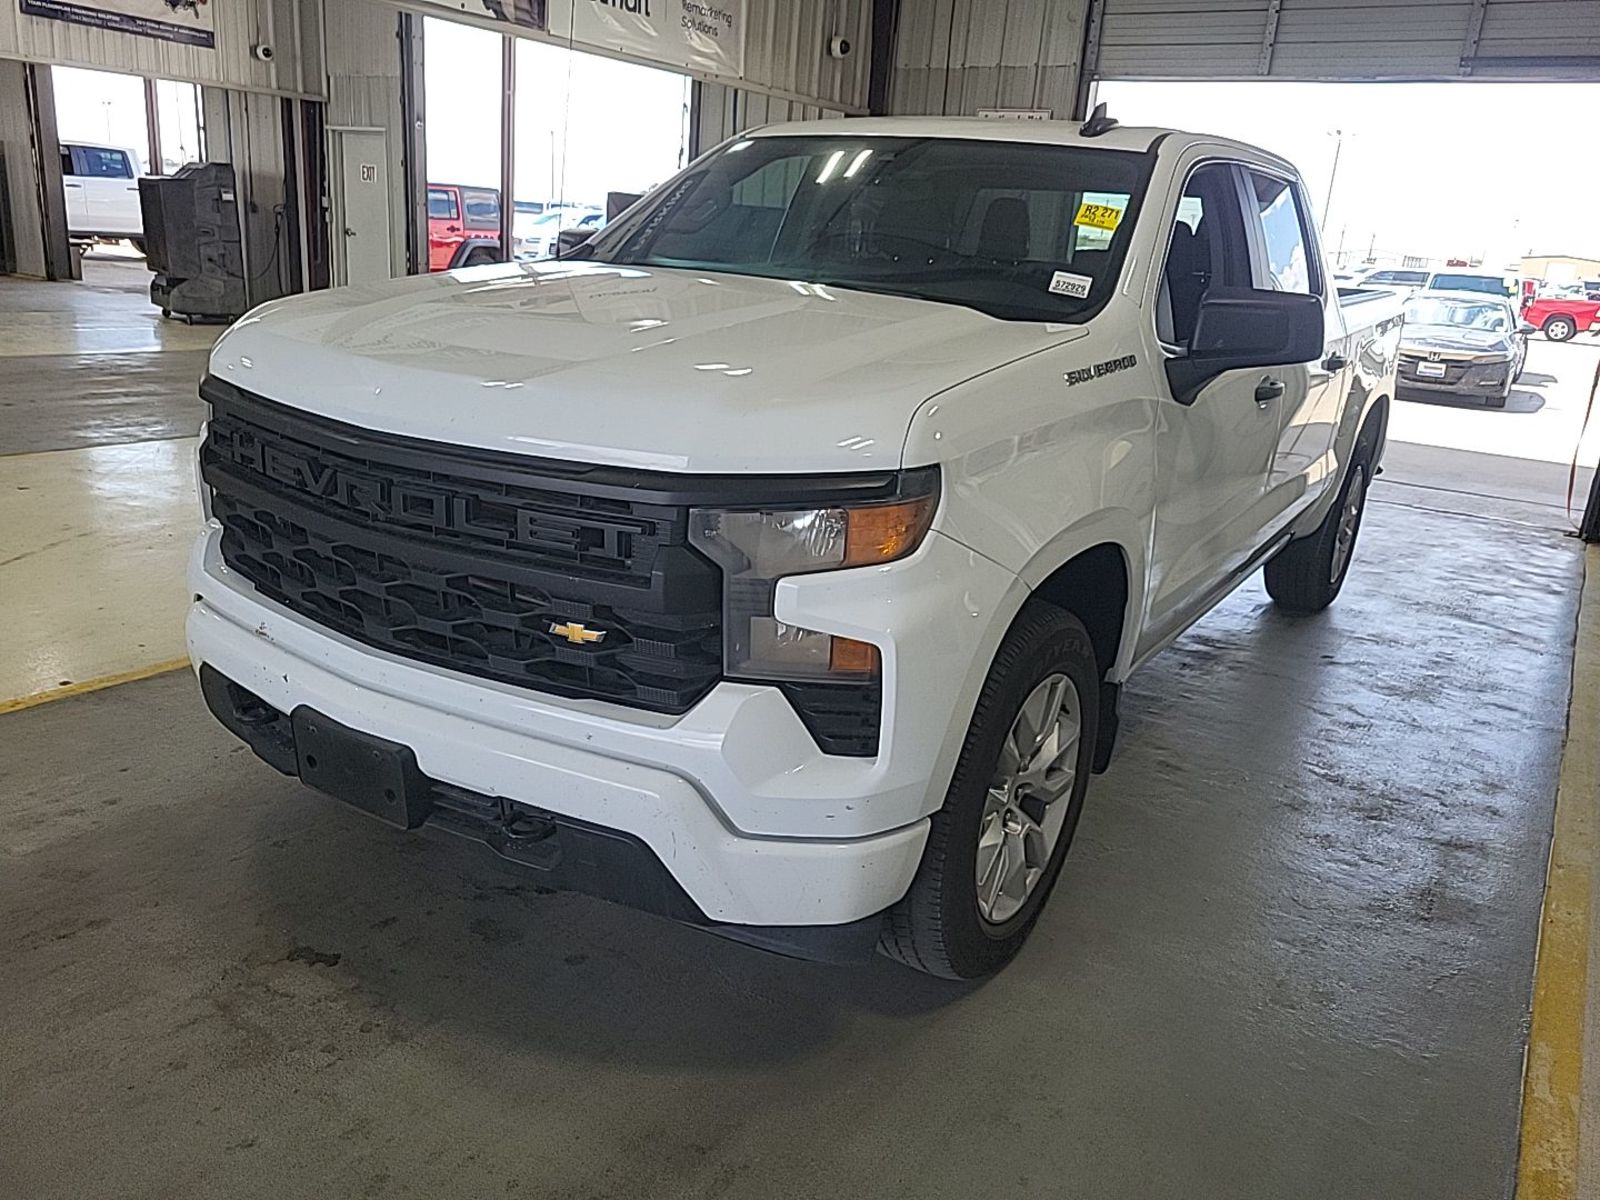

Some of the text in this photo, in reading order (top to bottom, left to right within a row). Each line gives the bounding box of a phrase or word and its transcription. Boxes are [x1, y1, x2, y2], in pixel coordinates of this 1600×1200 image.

[682, 0, 732, 28] Remarketing
[681, 15, 718, 37] Solutions
[361, 164, 375, 183] EXIT
[1083, 204, 1100, 217] R2
[1101, 206, 1121, 220] 271
[1055, 279, 1087, 293] 572929
[1063, 354, 1138, 387] SILVERADO
[209, 422, 649, 561] CHEVROLET
